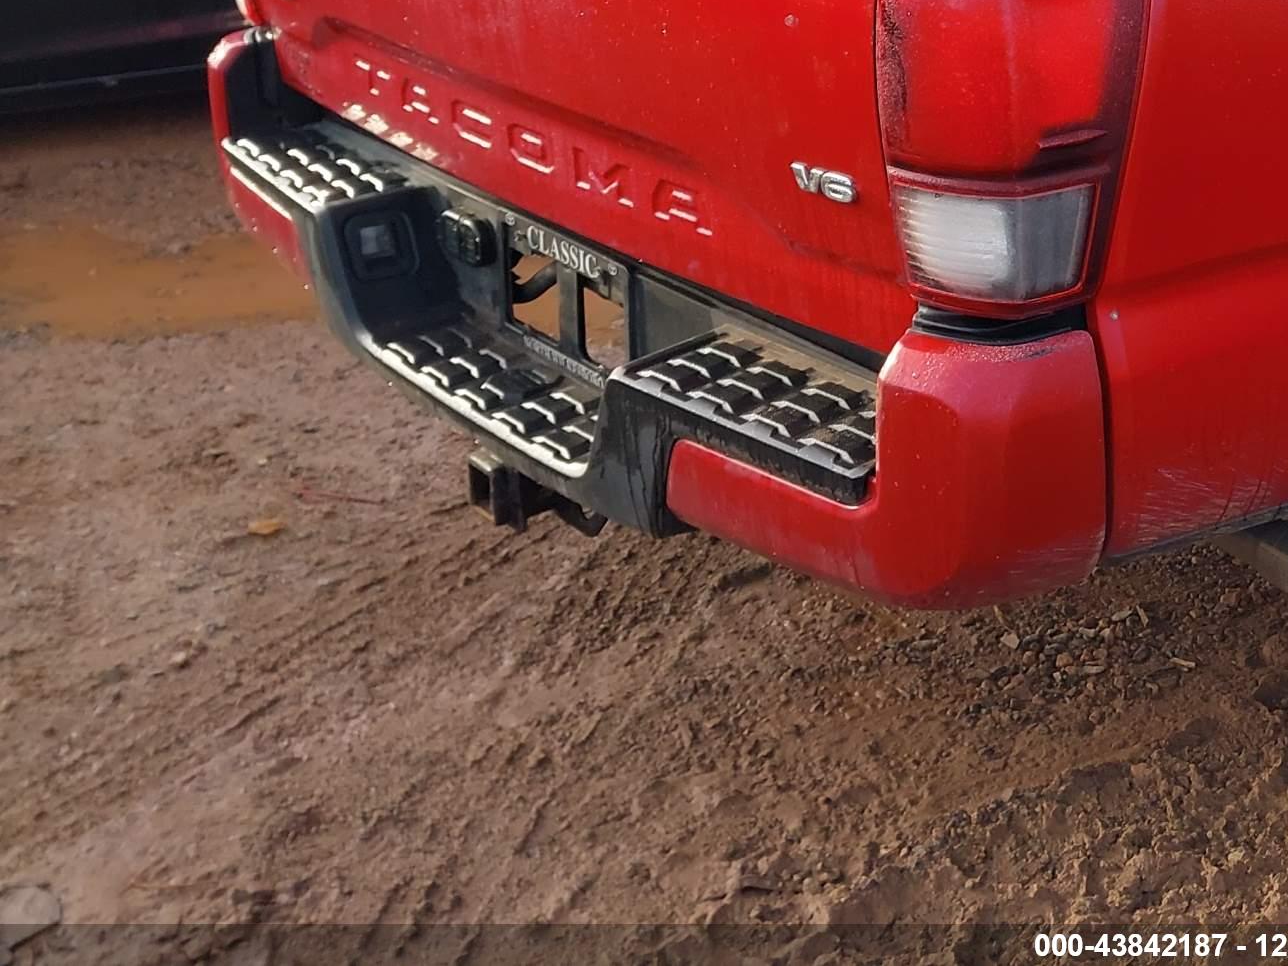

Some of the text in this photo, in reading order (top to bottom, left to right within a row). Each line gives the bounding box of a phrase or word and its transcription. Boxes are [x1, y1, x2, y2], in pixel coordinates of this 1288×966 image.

[354, 53, 713, 236] TACOMA
[790, 161, 857, 203] V6
[526, 225, 601, 279] CLASSIC
